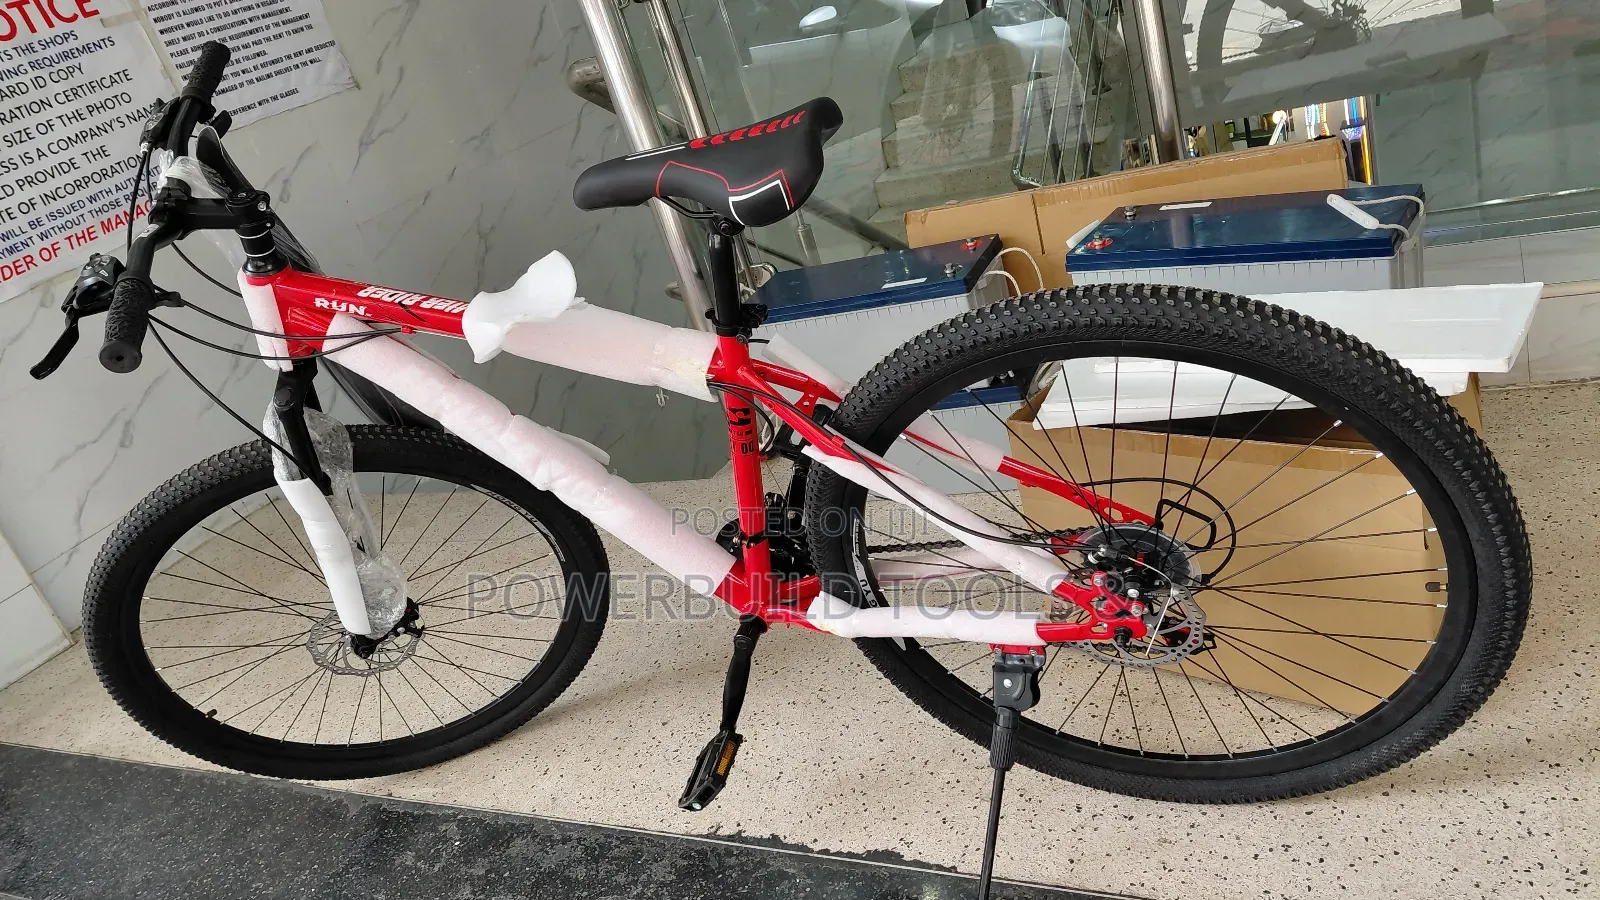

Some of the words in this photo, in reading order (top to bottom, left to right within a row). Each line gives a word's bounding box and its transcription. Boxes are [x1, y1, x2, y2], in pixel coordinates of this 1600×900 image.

[0, 0, 100, 42] OTICE
[152, 12, 175, 24] NOBODY
[175, 10, 182, 18] IS
[182, 5, 206, 16] ALLOWED
[205, 2, 213, 10] TO
[158, 23, 186, 36] WHOEVER
[185, 18, 204, 28] WOULD
[204, 14, 215, 23] LIKE
[215, 12, 223, 20] TO
[230, 4, 255, 16] ANYTHING
[164, 37, 181, 48] SHELF
[181, 32, 197, 41] MUST
[197, 30, 206, 38] DO
[209, 18, 248, 35] CONSULTATIONS
[247, 14, 261, 23] WITH
[11, 42, 38, 57] THE
[38, 29, 79, 51] SHOPS
[28, 36, 116, 72] REQUIREMENTS
[169, 47, 189, 59] PLEASE
[218, 36, 228, 44] THE
[228, 26, 265, 41] REQUIREMENTS
[271, 20, 281, 29] THE
[281, 12, 311, 26] MANAGEMENT
[241, 41, 252, 50] HAS
[262, 35, 273, 44] THE
[272, 32, 285, 40] RENT
[285, 29, 292, 37] TO
[291, 26, 305, 35] KNOW
[304, 23, 314, 31] THE
[230, 70, 241, 78] YOU
[240, 66, 253, 75] WILL
[259, 56, 284, 70] REFUNDED
[283, 53, 293, 61] THE
[293, 49, 305, 58] RENT
[304, 46, 314, 54] AND
[314, 39, 336, 52] DEDUCTED
[234, 57, 242, 65] BE
[0, 81, 29, 101] ARD
[30, 75, 47, 91] ID
[49, 62, 85, 84] COPY
[0, 96, 54, 126] RATION
[54, 68, 133, 105] CERTIFICATE
[215, 84, 238, 97] DAMAGED
[238, 81, 245, 89] OF
[245, 78, 256, 86] THE
[274, 65, 293, 77] SHELVES
[292, 63, 300, 71] ON
[300, 60, 309, 68] THE
[257, 97, 270, 107] WITH
[270, 94, 280, 103] THE
[2, 126, 36, 149] SIZE
[36, 118, 56, 137] OF
[56, 107, 88, 129] THE
[85, 91, 132, 119] PHOTO
[18, 151, 35, 167] IS
[35, 147, 49, 161] A
[47, 116, 126, 155] COMPANY'S
[15, 157, 81, 192] PROVIDE
[81, 144, 112, 164] THE
[0, 225, 28, 243] WILL
[28, 214, 46, 231] BE
[46, 199, 86, 222] ISSUED
[86, 187, 114, 204] WITH
[17, 197, 38, 215] OF
[36, 213, 87, 242] WITHOUT
[87, 197, 124, 219] THOSE
[38, 241, 62, 262] OF
[64, 225, 99, 250] THE
[313, 297, 367, 316] RUN
